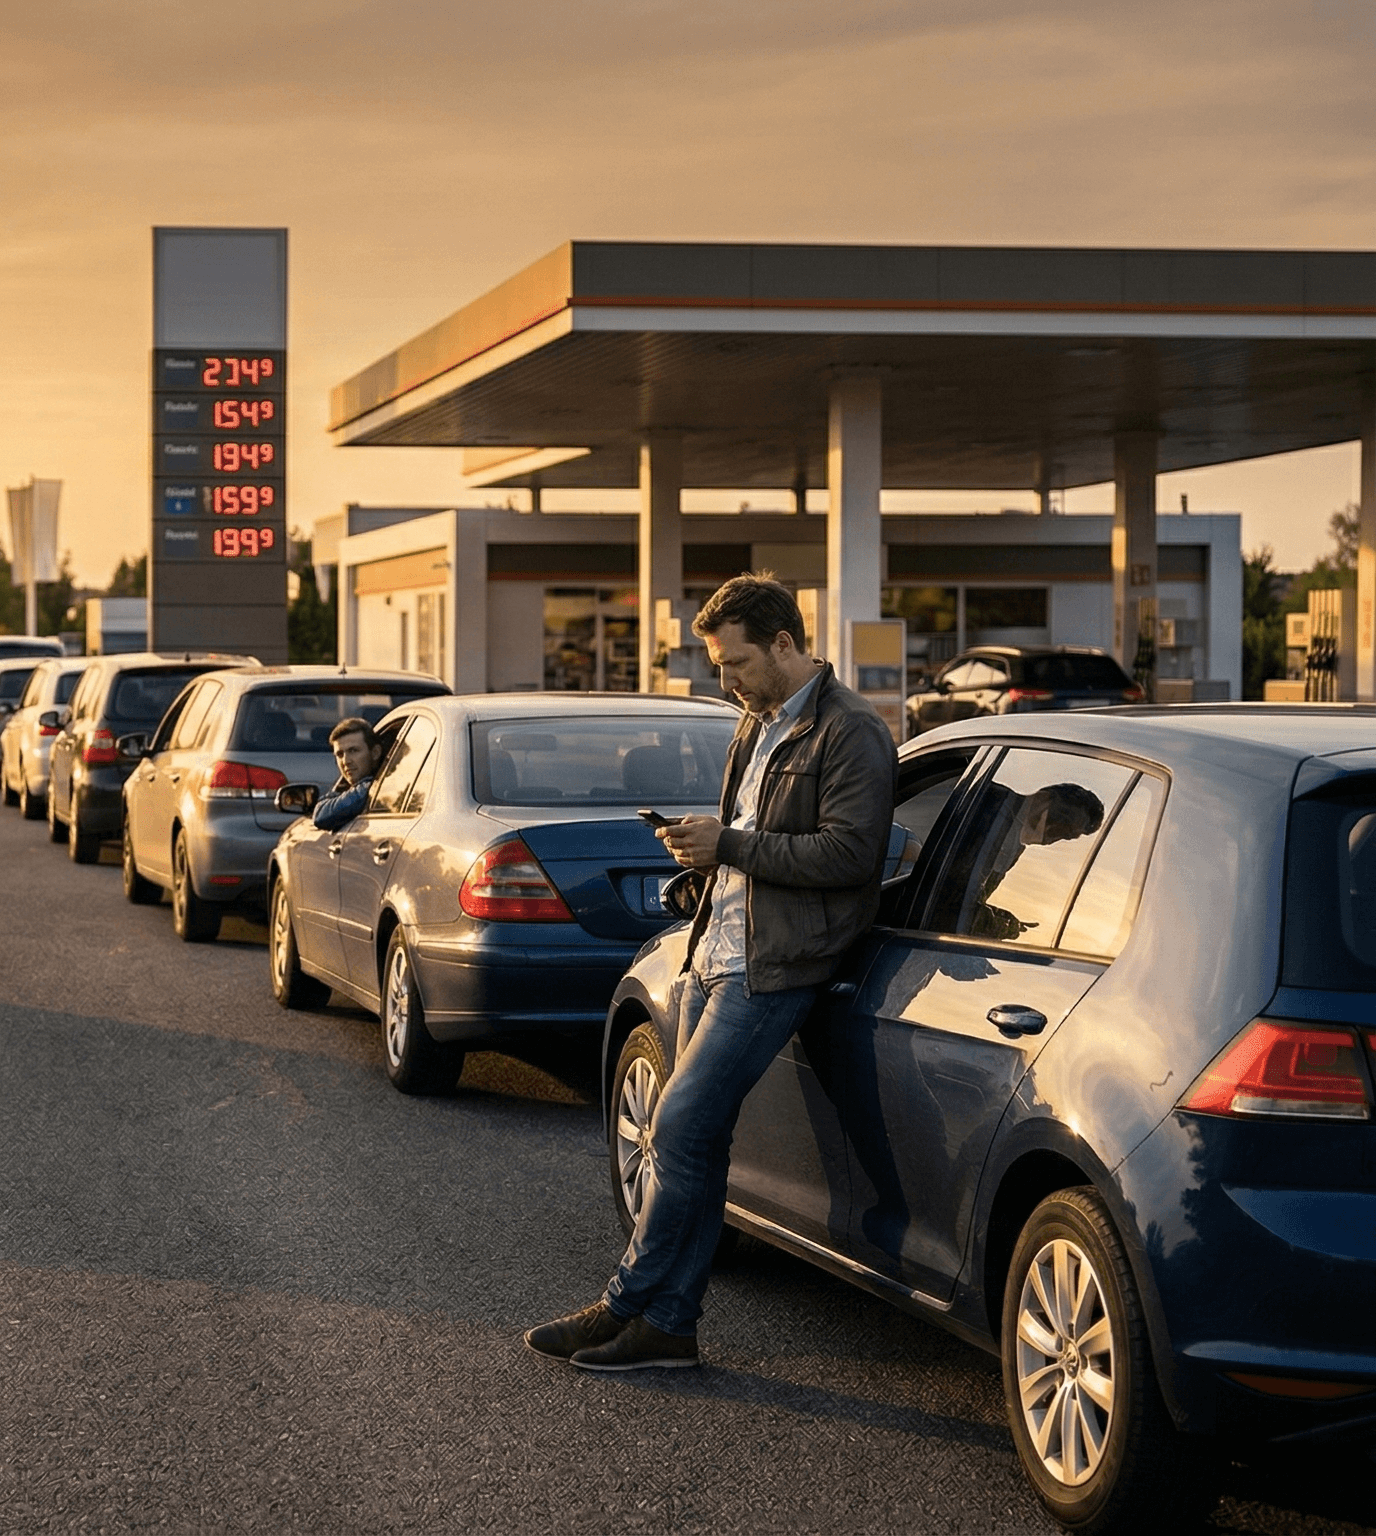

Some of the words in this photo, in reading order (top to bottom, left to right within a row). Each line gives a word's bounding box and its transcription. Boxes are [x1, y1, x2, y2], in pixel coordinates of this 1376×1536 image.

[214, 400, 273, 428] 1549
[214, 443, 273, 471] 1949
[214, 486, 273, 514] 1599
